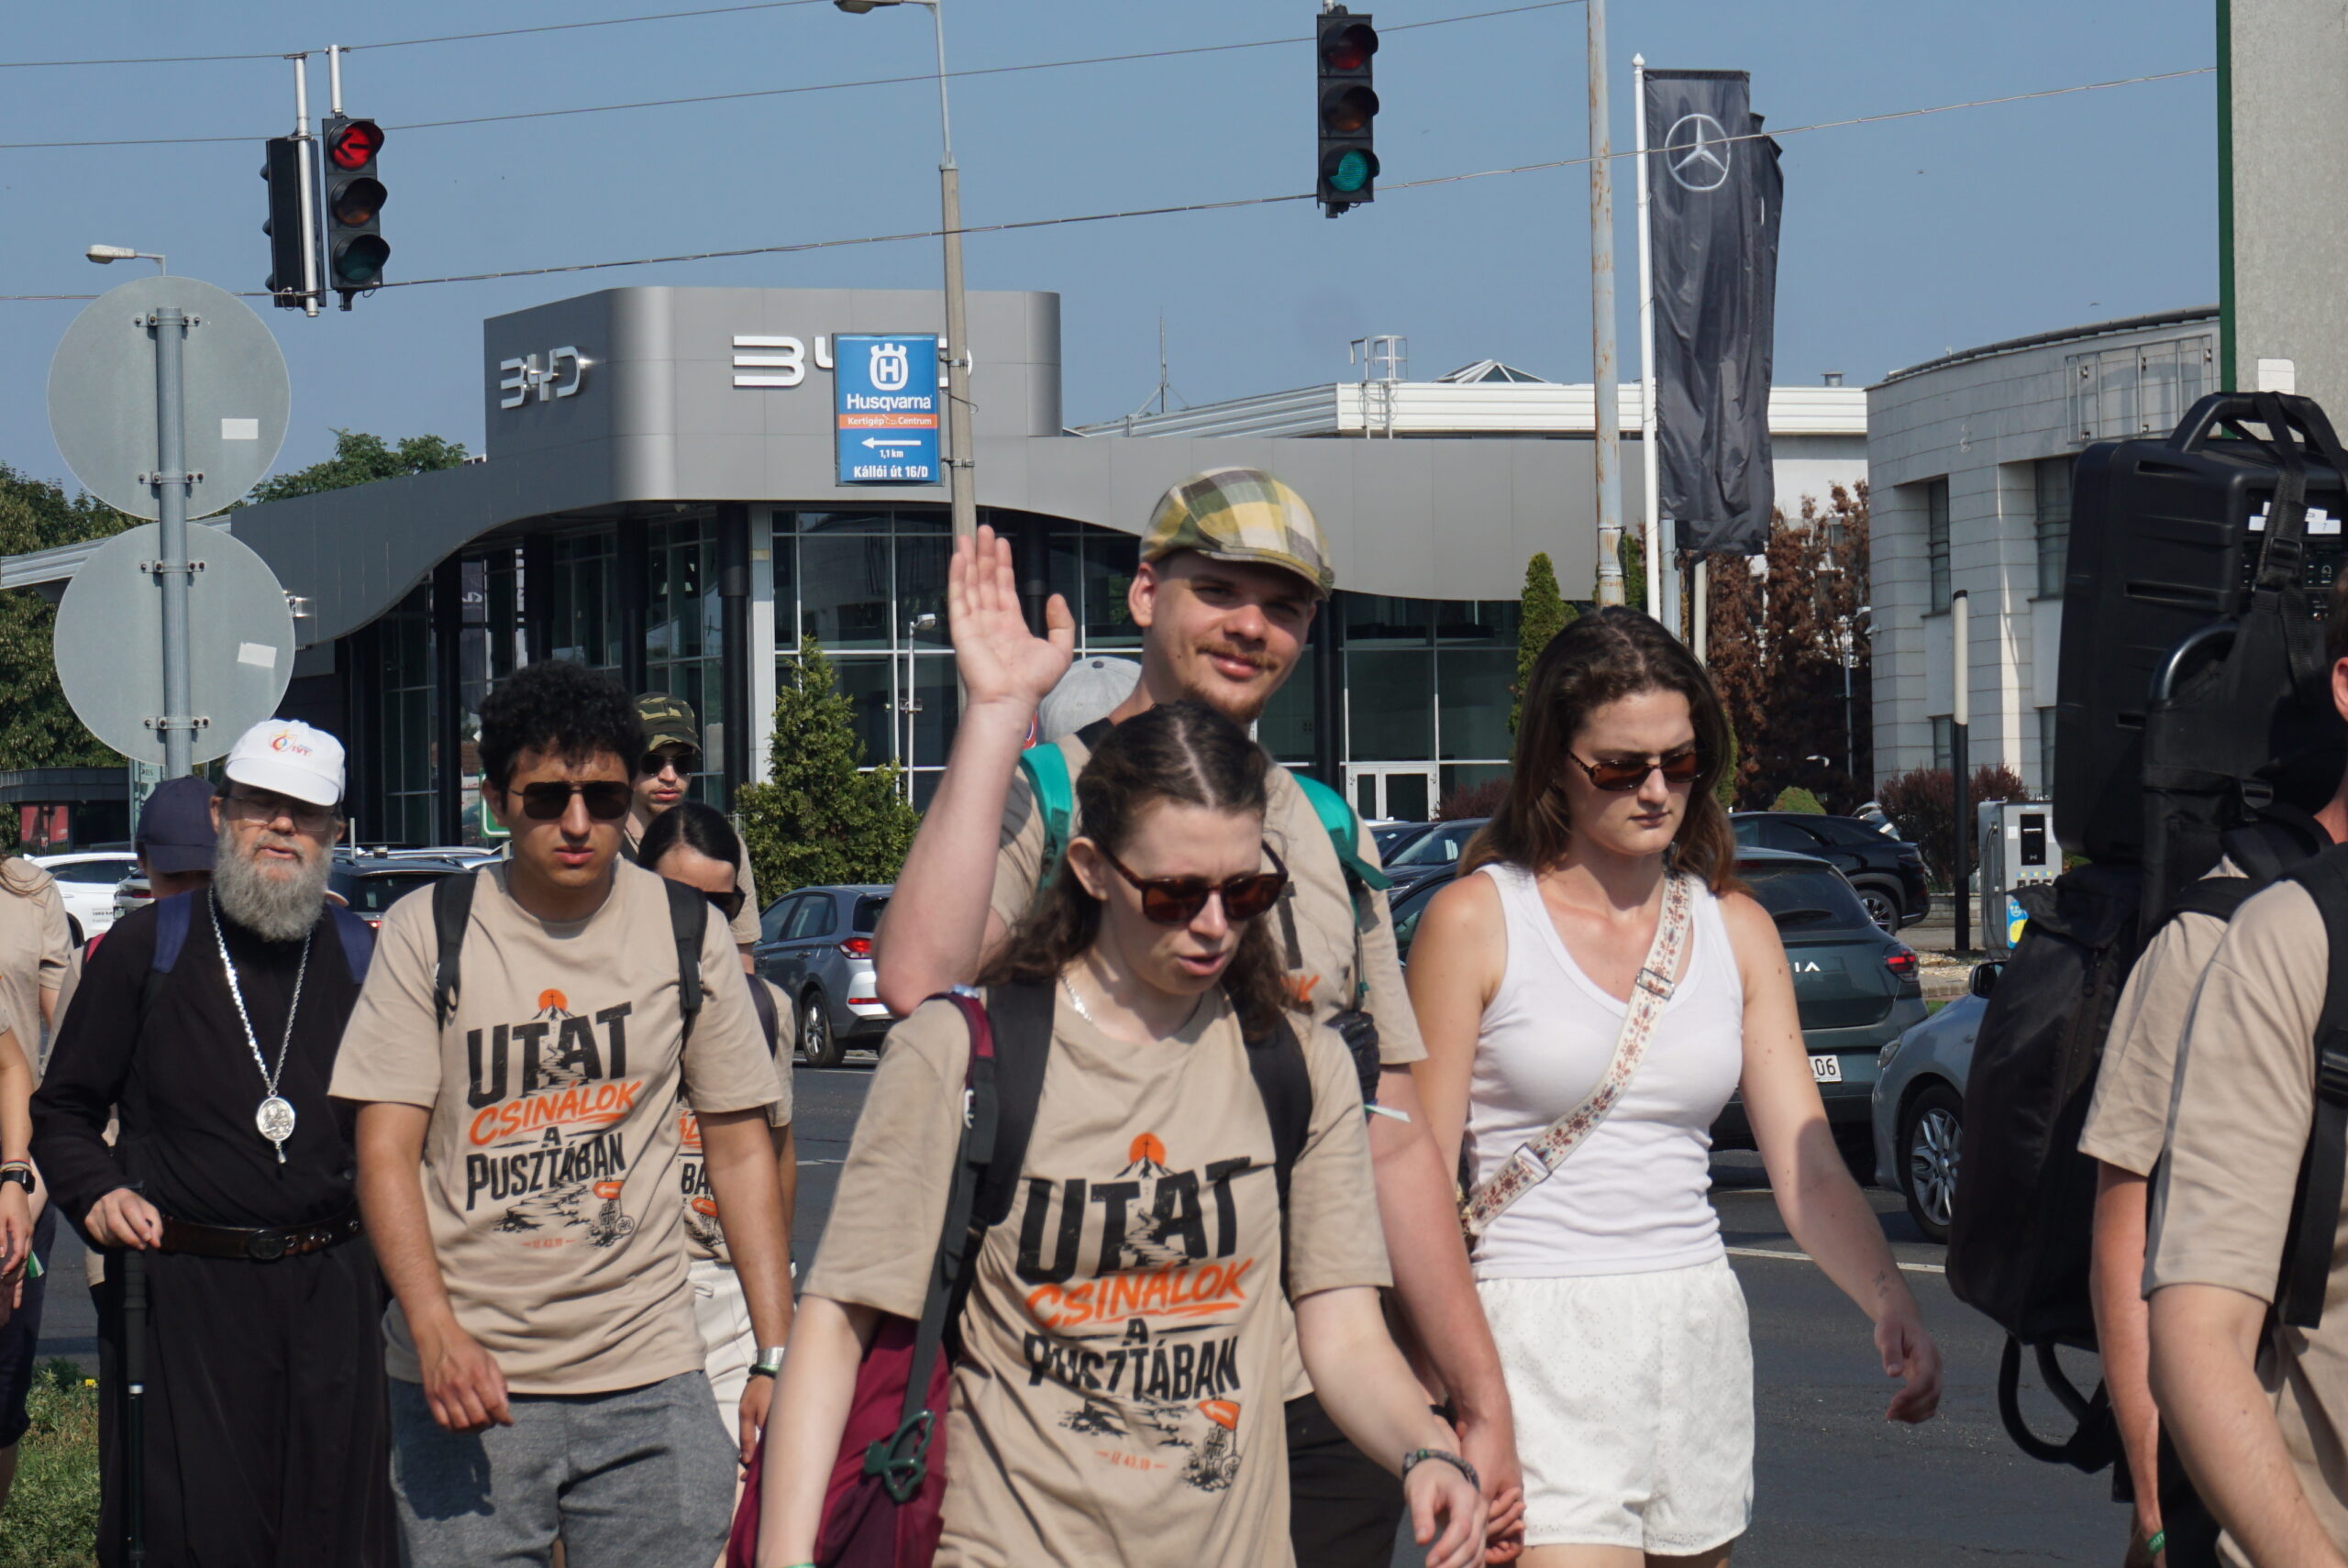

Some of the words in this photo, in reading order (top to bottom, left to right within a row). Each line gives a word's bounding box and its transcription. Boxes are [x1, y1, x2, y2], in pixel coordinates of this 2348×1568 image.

[500, 346, 581, 410] BYD
[847, 392, 932, 412] Husqvarna
[847, 416, 885, 427] Kertigép
[898, 416, 932, 425] Centrum
[880, 448, 891, 459] 1,1
[892, 448, 904, 458] km
[853, 465, 888, 478] Kállói
[890, 465, 903, 478] út
[904, 465, 929, 479] 16/D
[1788, 961, 1822, 973] IA
[466, 1000, 633, 1110] UTAT
[469, 1078, 643, 1146] CSINÁLOK
[541, 1126, 561, 1147] A
[465, 1131, 626, 1211] PUSZTÁBAN
[1014, 1155, 1251, 1285] UTAT
[1024, 1256, 1255, 1329] CSINÁLOK
[1123, 1317, 1149, 1346] A
